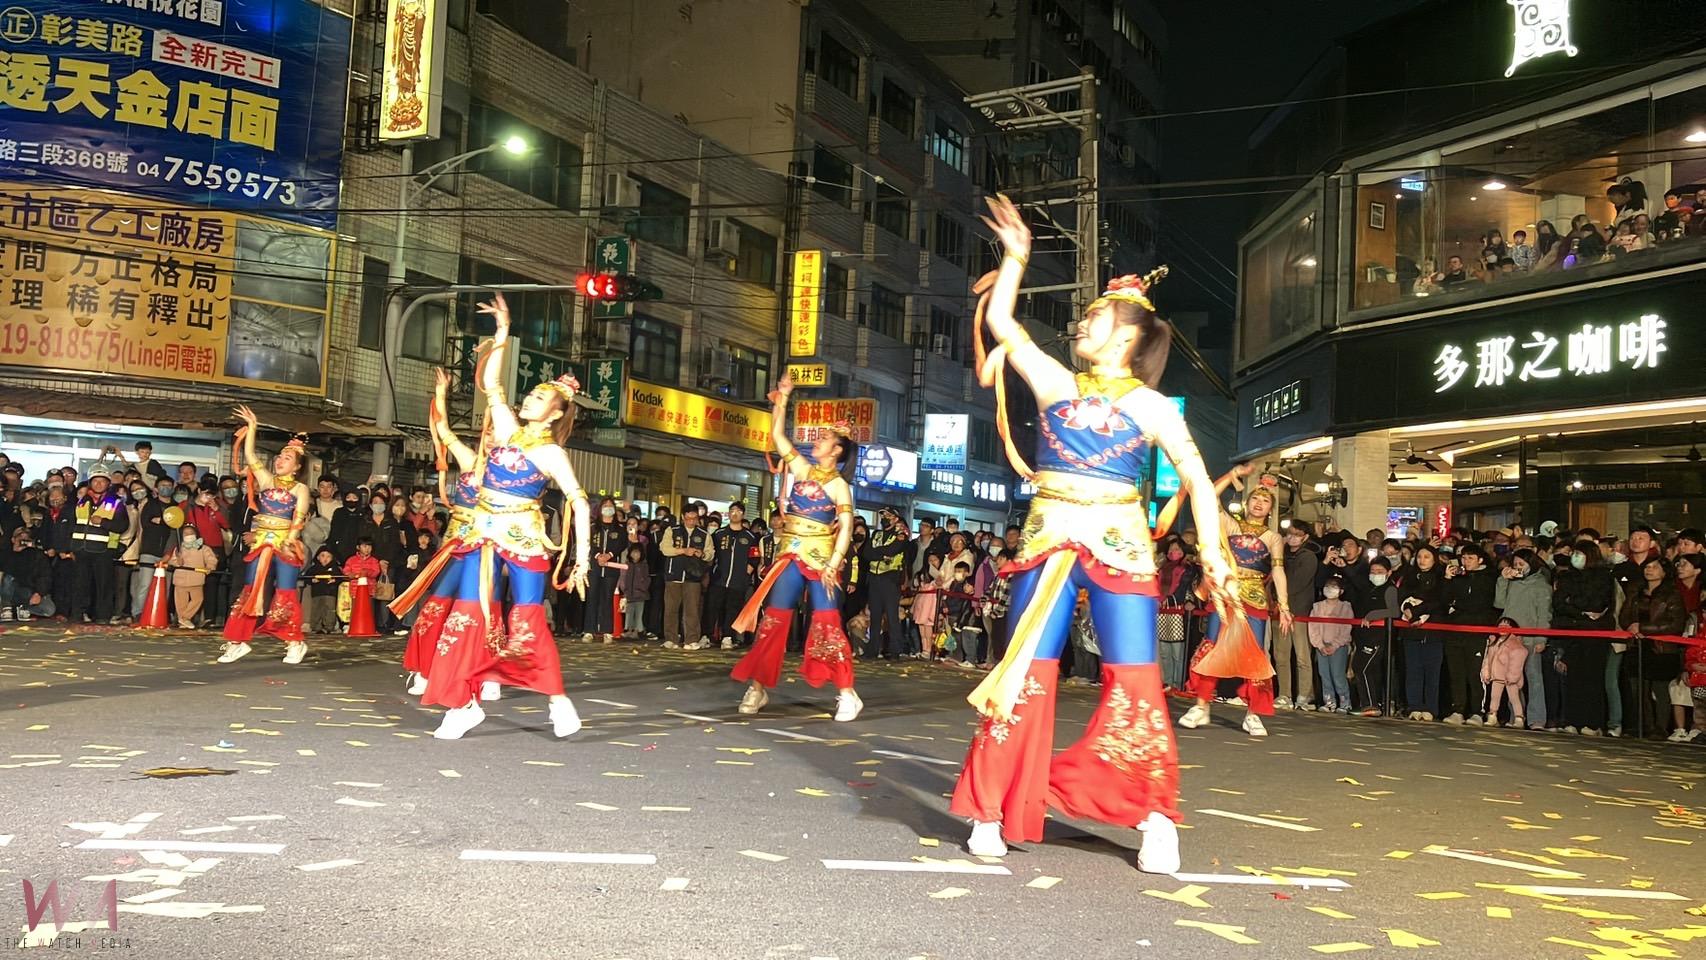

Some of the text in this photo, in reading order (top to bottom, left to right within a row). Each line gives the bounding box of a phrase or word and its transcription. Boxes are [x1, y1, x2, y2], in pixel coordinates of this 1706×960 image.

[159, 35, 274, 84] 全新完工
[0, 52, 280, 152] 透天金店面
[137, 161, 160, 178] 04
[163, 156, 297, 206] 7559573
[0, 192, 225, 254] 市區乙工廠房
[67, 283, 213, 331] 稀有釋出
[1432, 313, 1668, 394] 多那之咖啡
[632, 388, 664, 408] Kodak
[723, 408, 750, 427] Kodak
